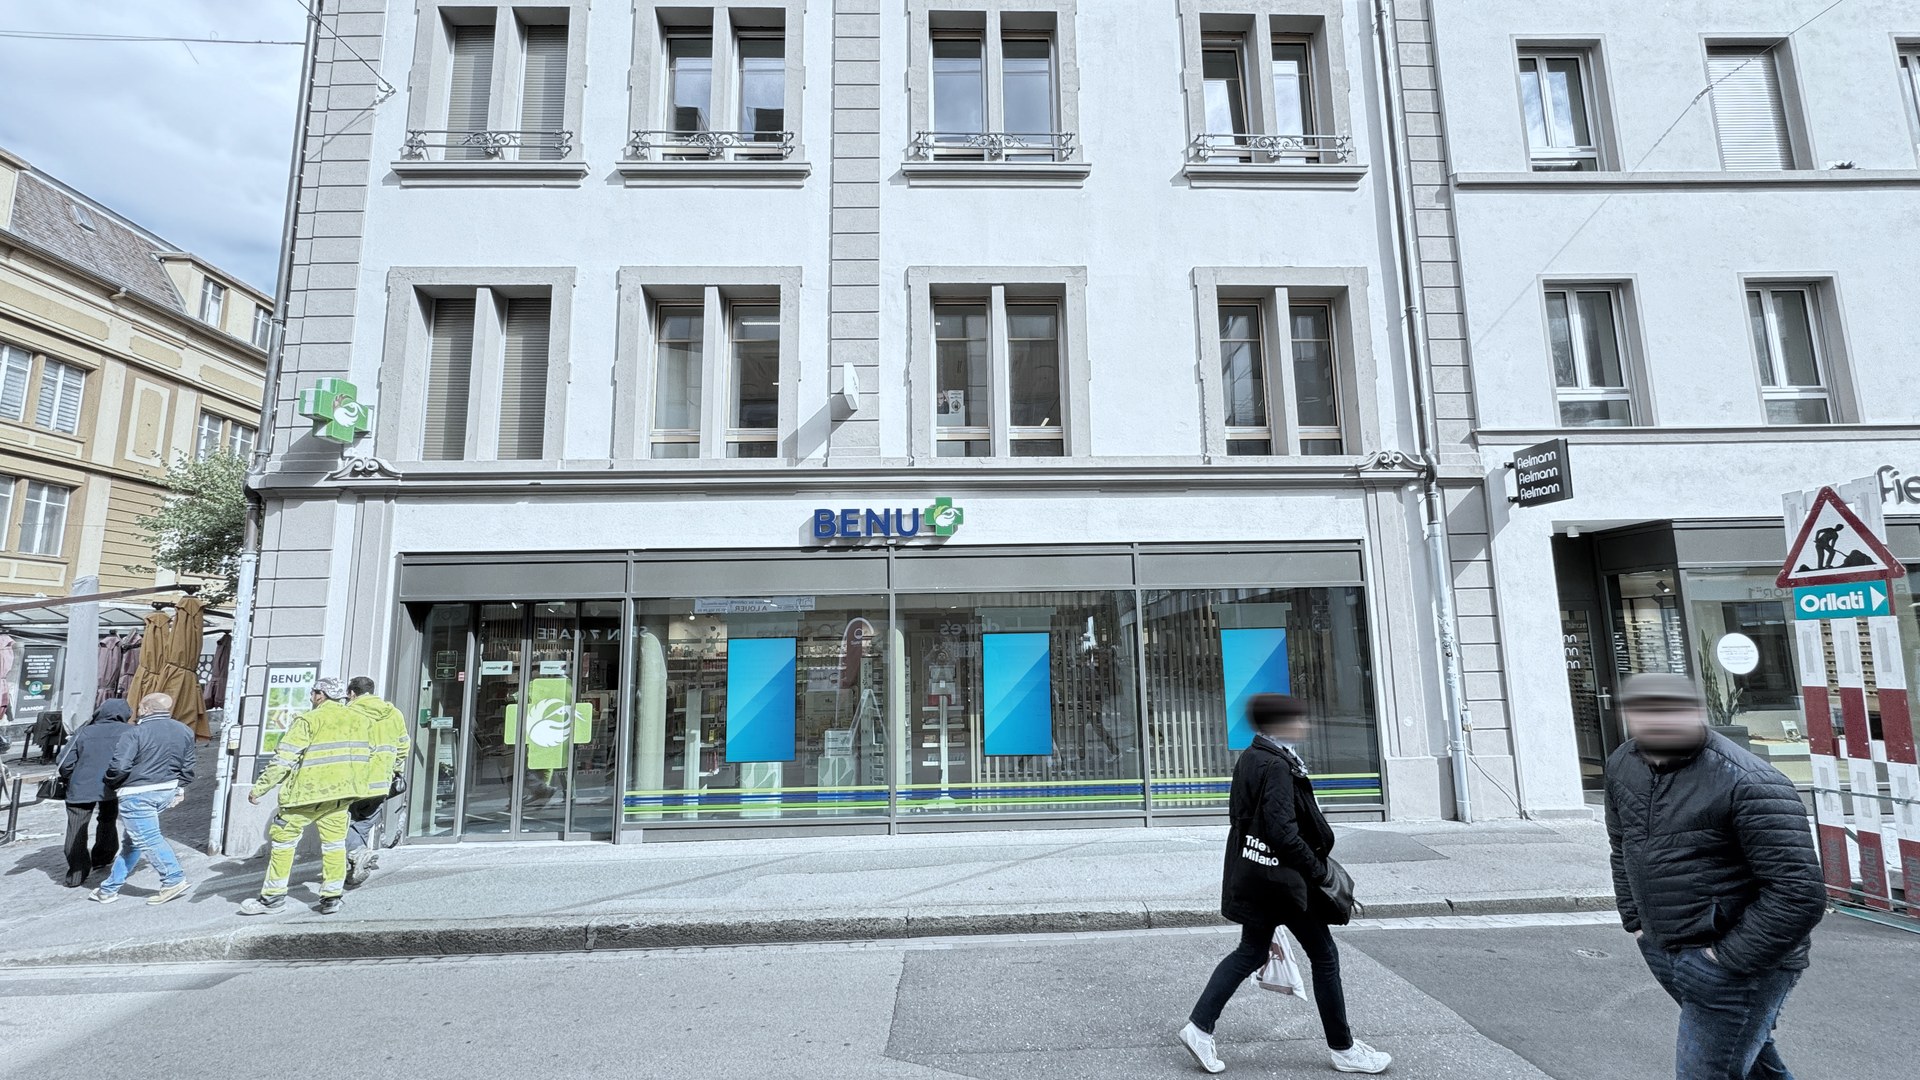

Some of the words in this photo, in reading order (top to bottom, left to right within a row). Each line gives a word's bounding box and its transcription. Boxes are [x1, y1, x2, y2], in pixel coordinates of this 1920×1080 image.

[814, 508, 919, 538] BENU
[1800, 591, 1865, 612] Orllati
[271, 675, 301, 683] BENU
